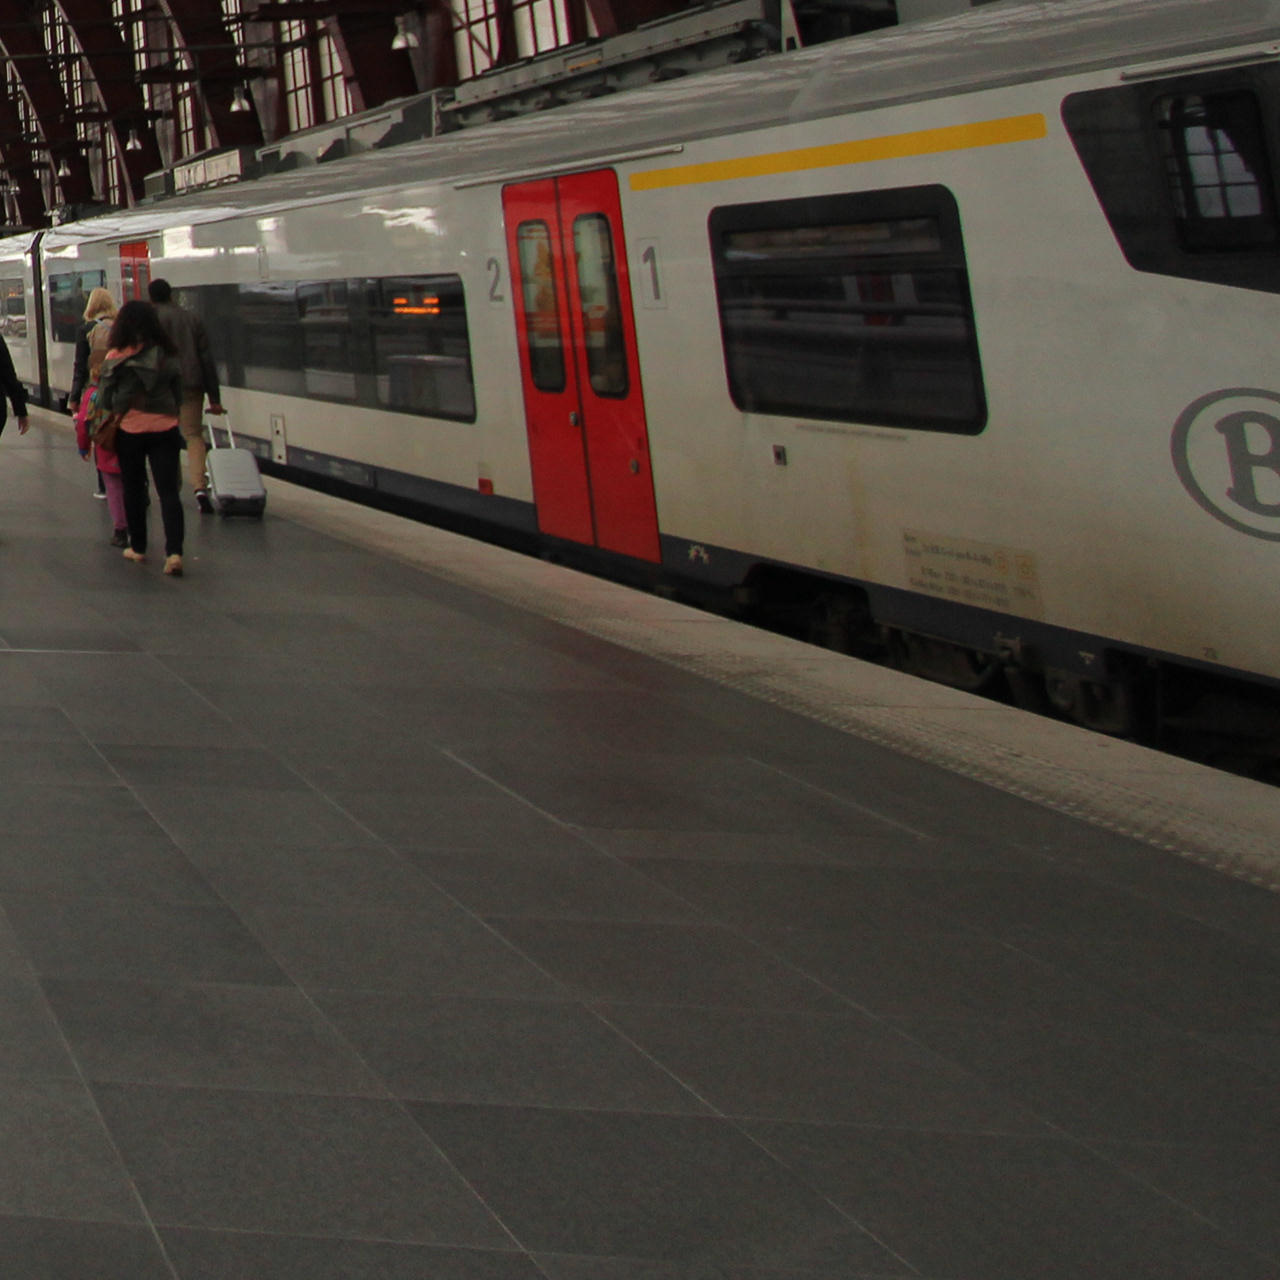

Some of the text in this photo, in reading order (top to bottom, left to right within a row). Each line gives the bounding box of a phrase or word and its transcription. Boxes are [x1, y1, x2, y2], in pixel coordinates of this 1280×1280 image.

[487, 257, 503, 302] 2
[642, 246, 661, 300] 1
[1214, 410, 1280, 518] B
